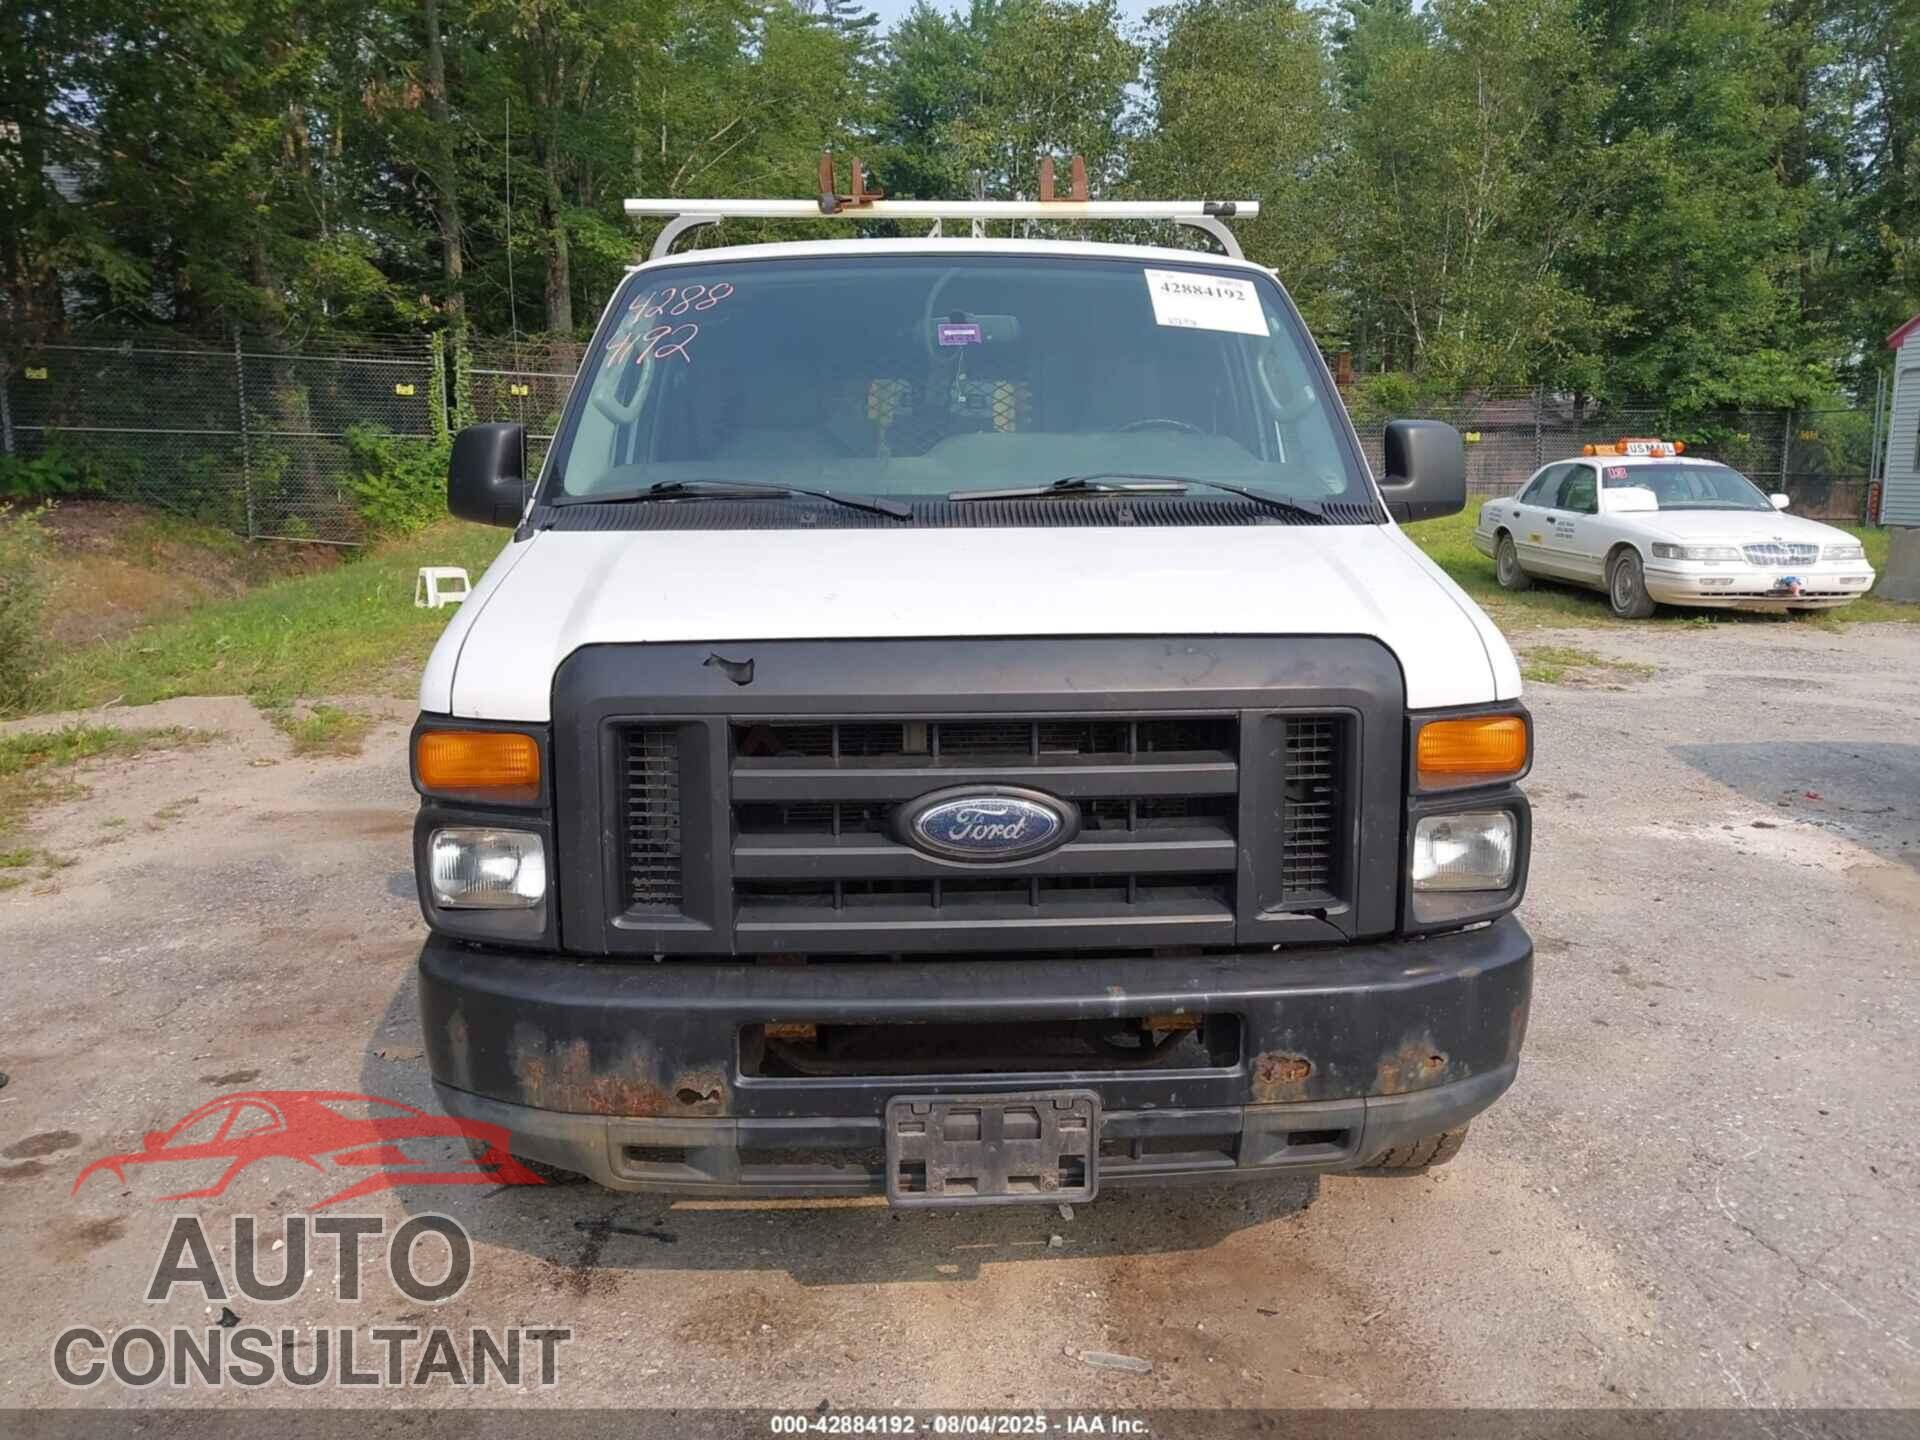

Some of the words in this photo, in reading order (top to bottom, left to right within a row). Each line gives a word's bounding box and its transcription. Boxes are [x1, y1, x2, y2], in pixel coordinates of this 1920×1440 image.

[628, 282, 734, 325] 4288
[1160, 281, 1246, 301] 42884192
[605, 323, 699, 368] 4192
[1629, 443, 1644, 454] US
[949, 806, 1026, 840] Ford
